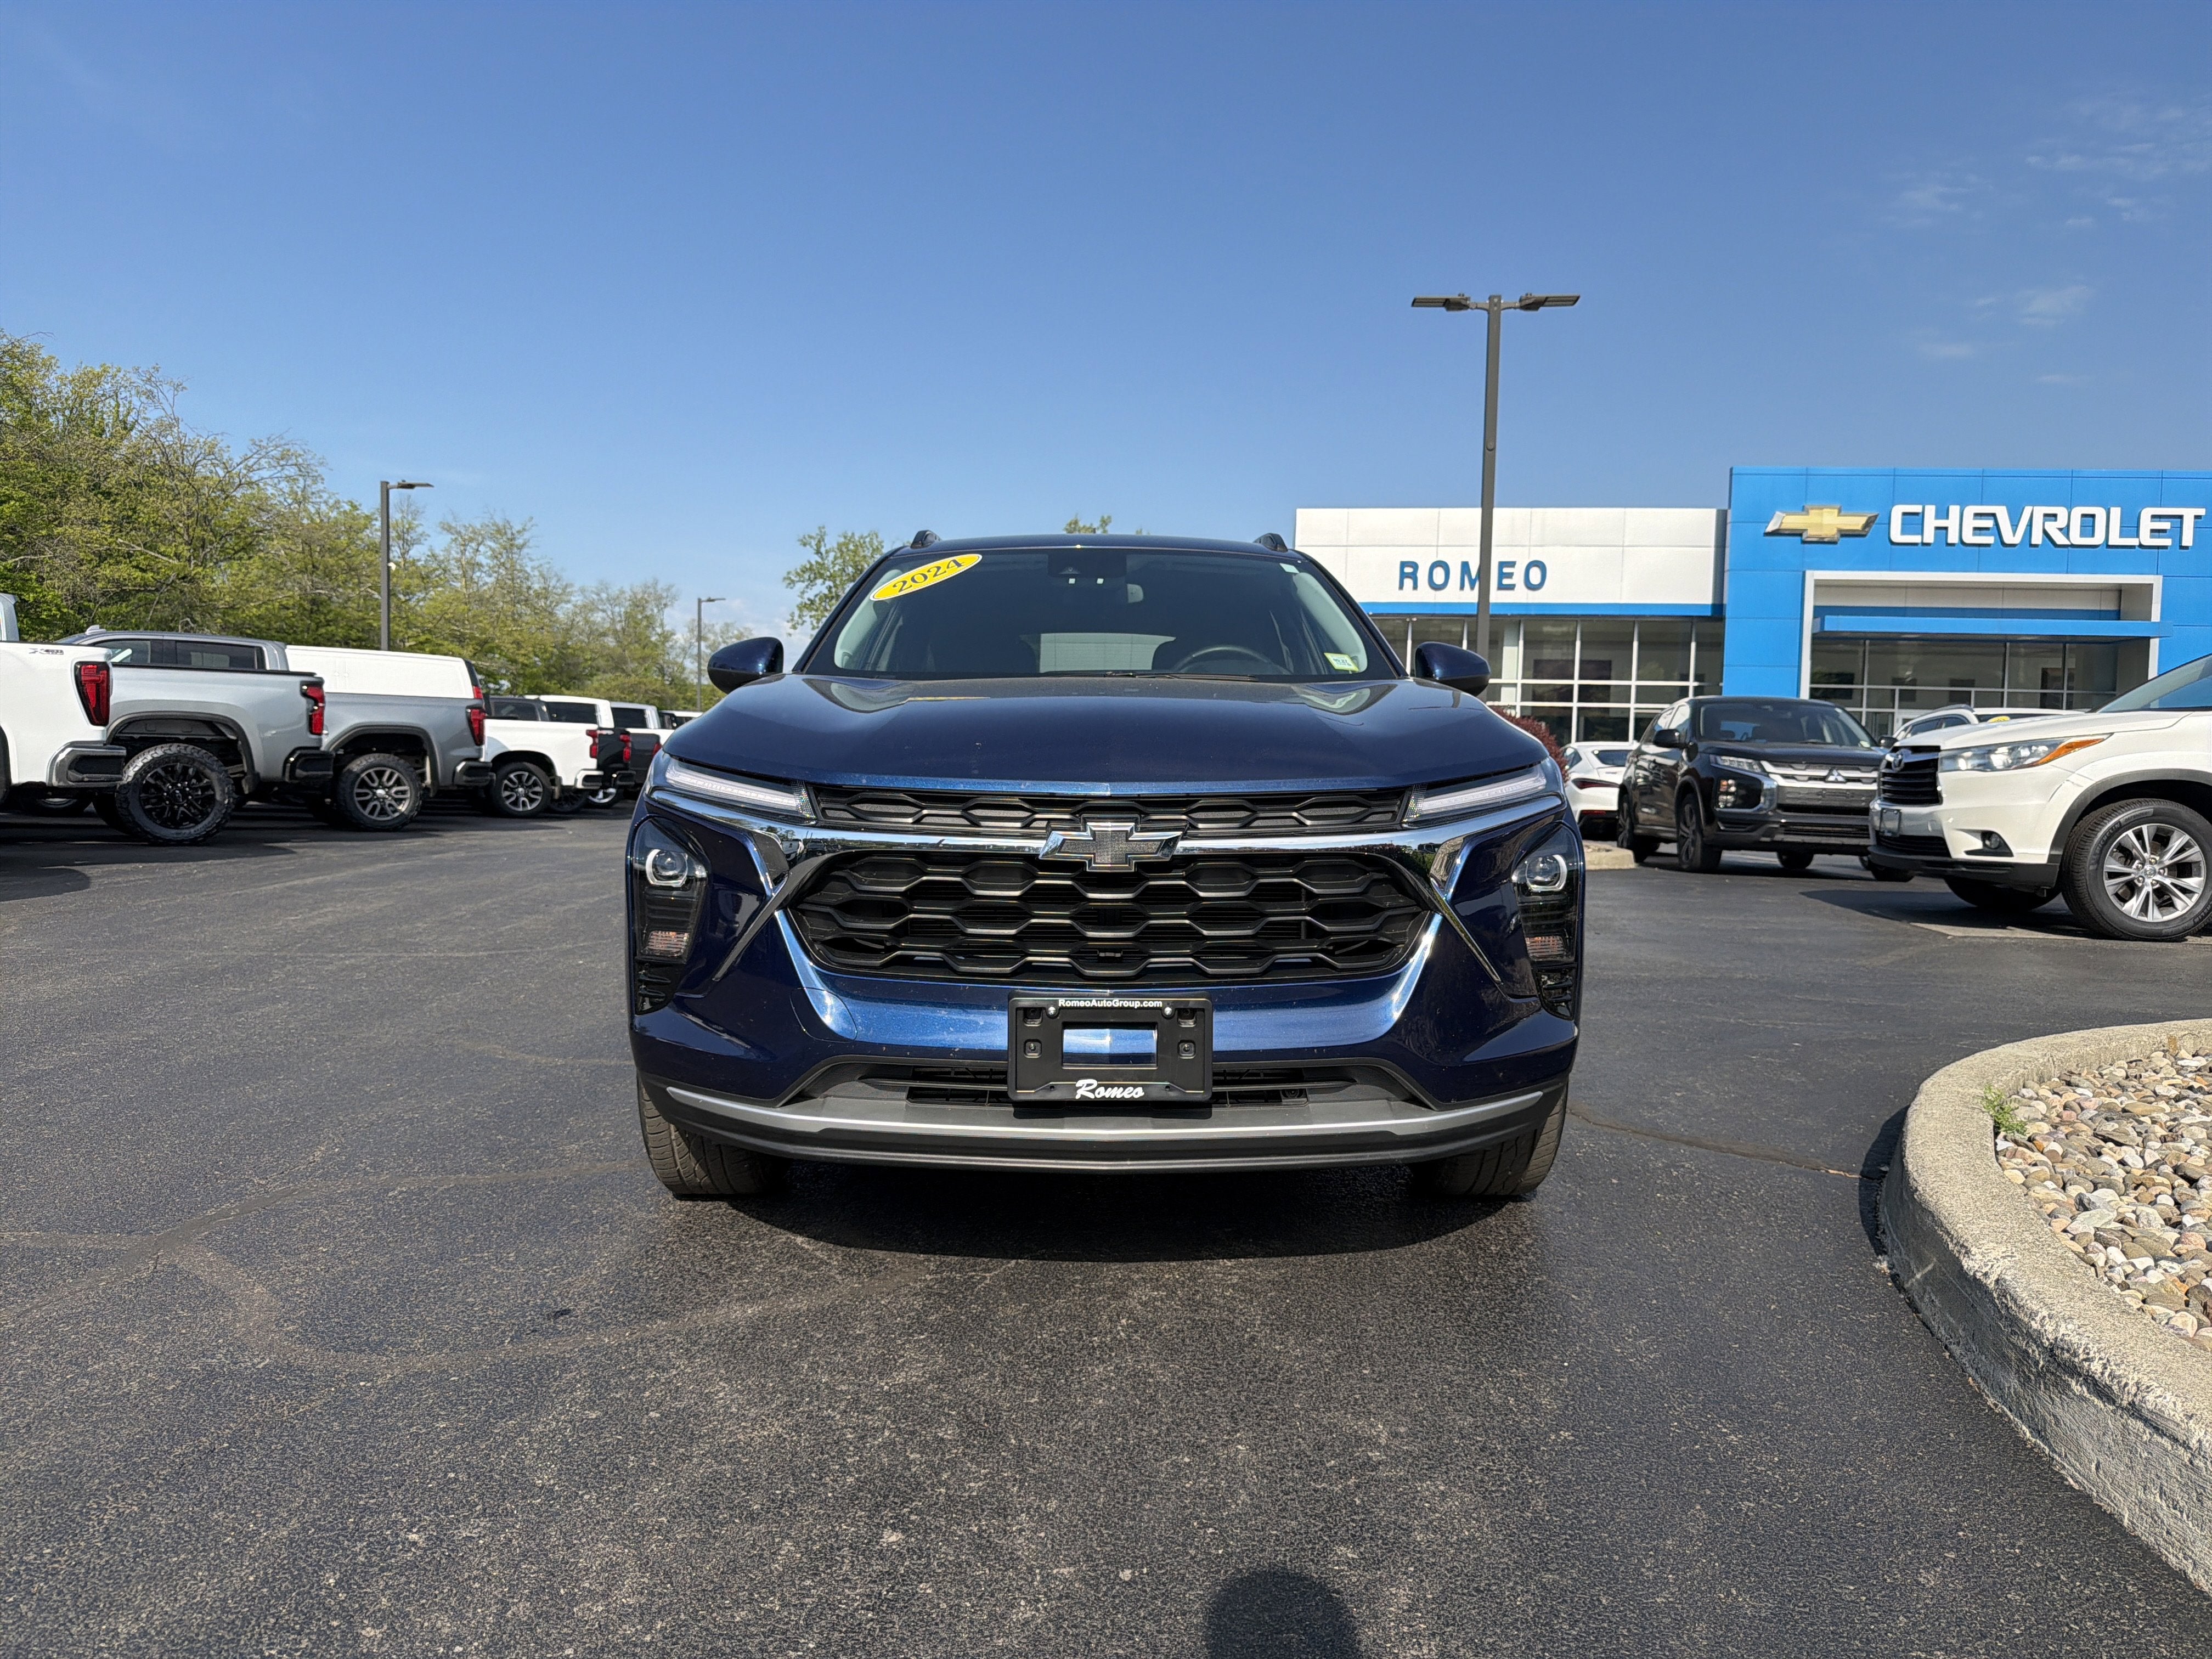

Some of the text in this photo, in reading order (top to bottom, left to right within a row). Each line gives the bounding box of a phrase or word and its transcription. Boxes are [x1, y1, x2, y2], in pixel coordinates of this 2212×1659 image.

[1889, 504, 2205, 548] CHEVROLET
[892, 558, 965, 593] 2024
[1398, 560, 1547, 591] ROMEO
[1058, 999, 1163, 1009] RomeoAutoGroup.com
[1075, 1079, 1145, 1099] Romeo
